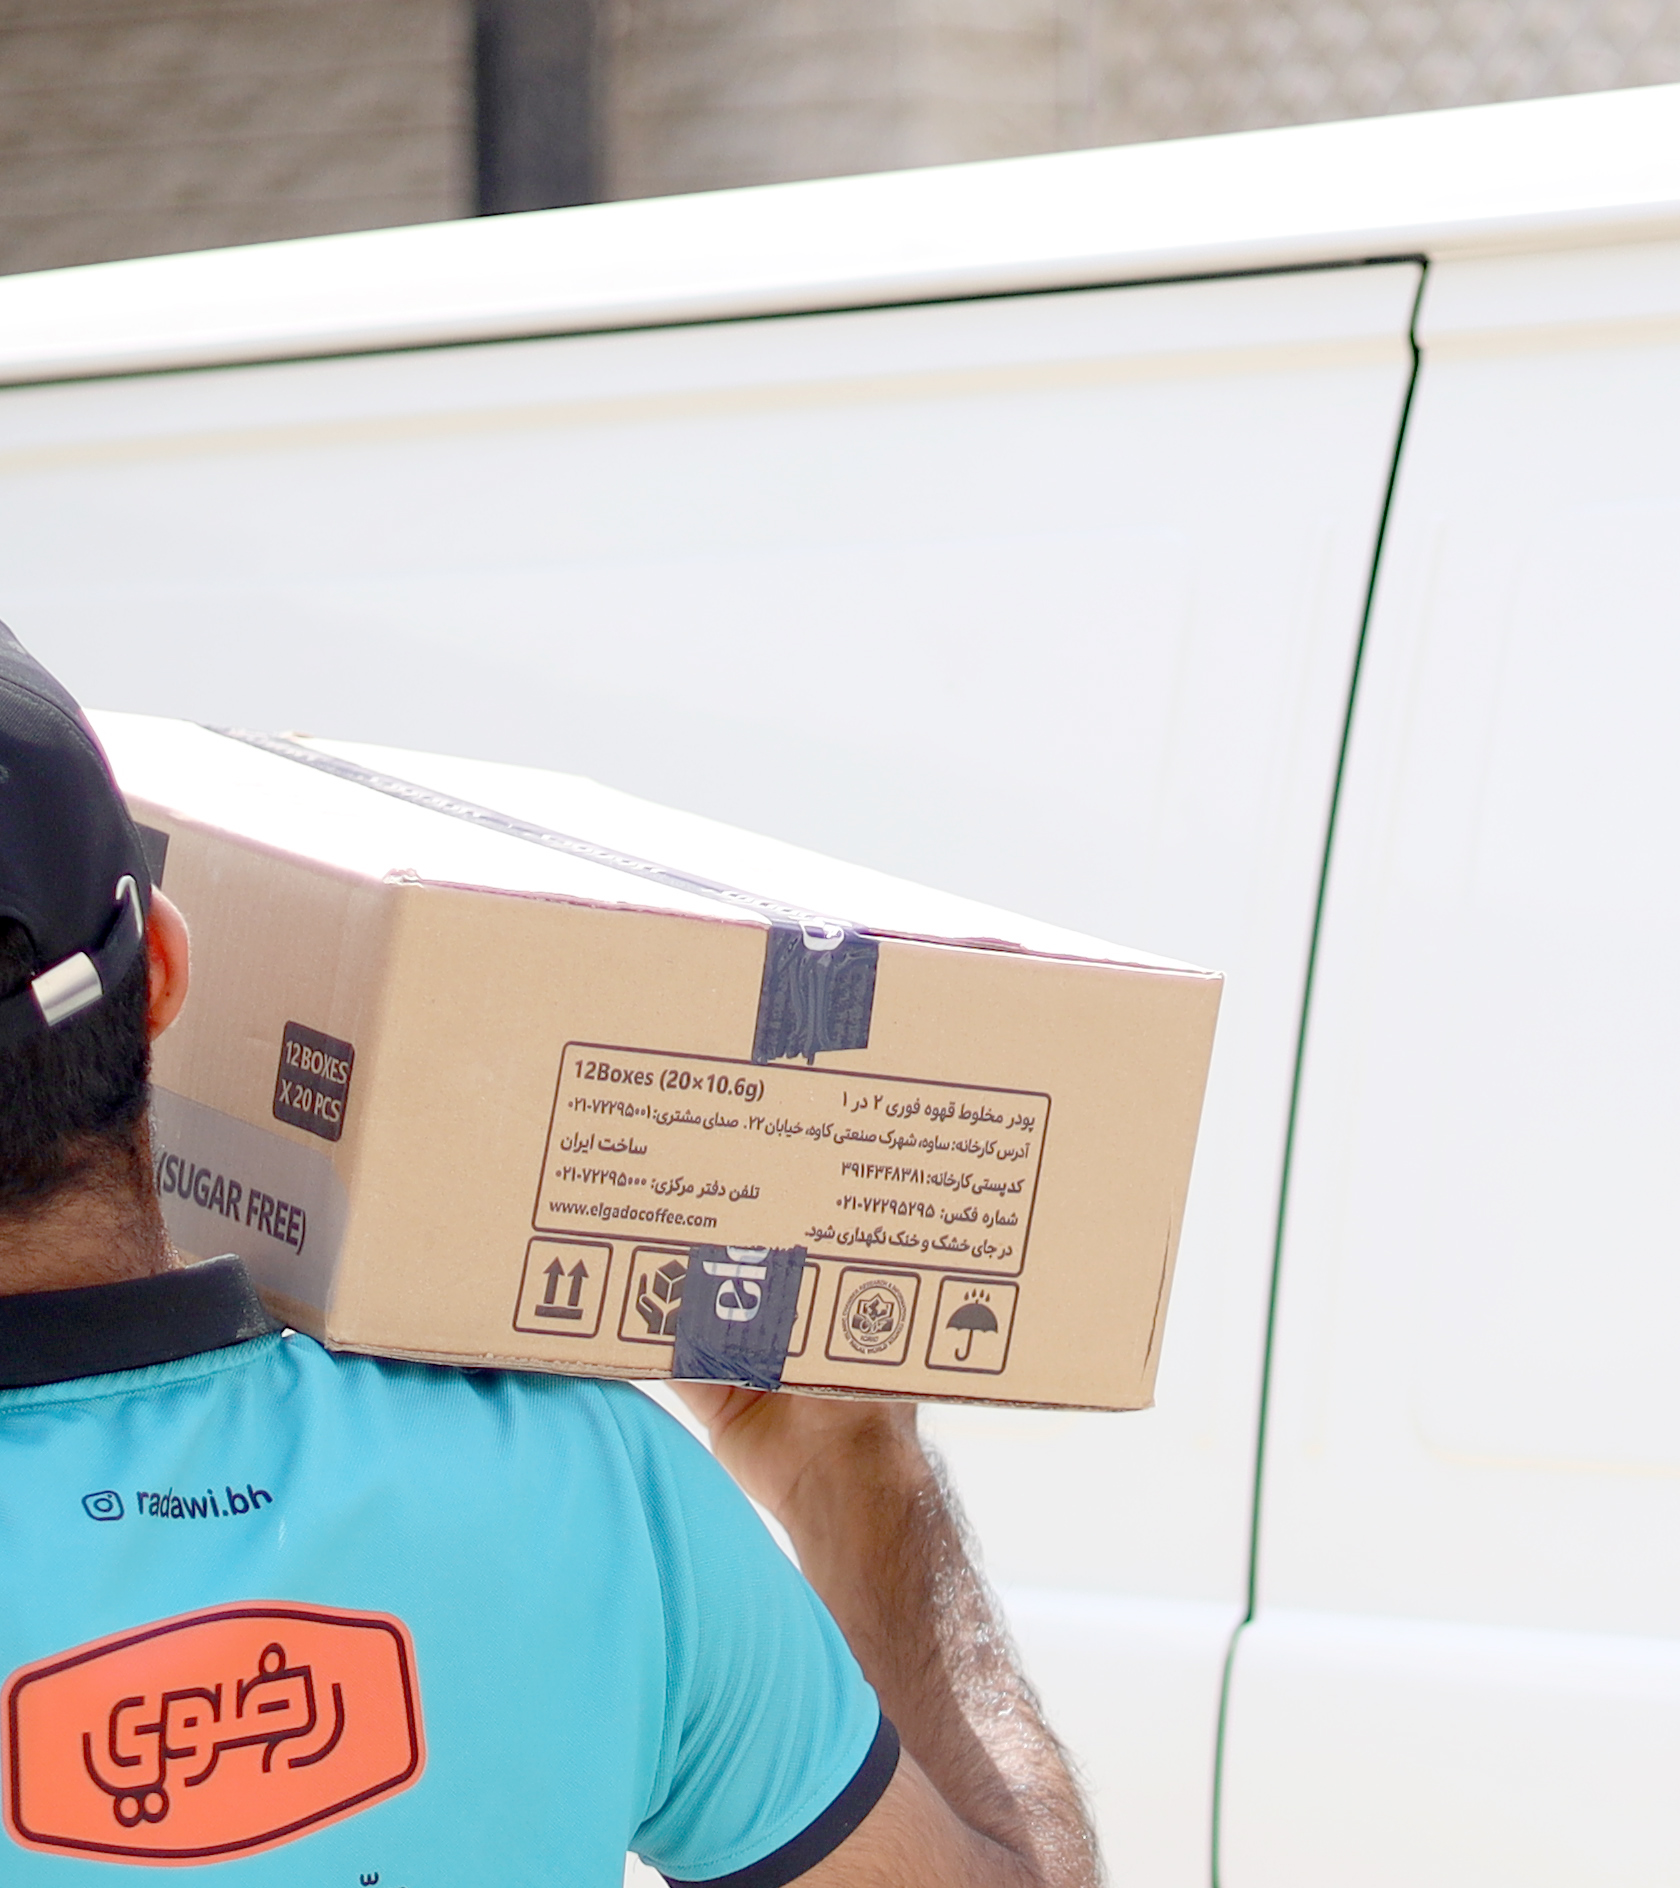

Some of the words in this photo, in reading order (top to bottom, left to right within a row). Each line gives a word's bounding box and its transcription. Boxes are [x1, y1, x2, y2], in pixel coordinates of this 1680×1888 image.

[574, 1060, 654, 1086] 12Boxes
[314, 1092, 341, 1123] PCS
[850, 1096, 868, 1113] در
[885, 1097, 921, 1118] فوری
[924, 1101, 956, 1122] قهوه
[958, 1102, 1004, 1126] مخلوط
[702, 1111, 739, 1131] صدای
[1005, 1113, 1036, 1133] پودر
[559, 1131, 595, 1154] ایران
[597, 1136, 648, 1156] ساخت
[833, 1128, 877, 1144] صنعتی
[878, 1129, 917, 1150] شهرک
[996, 1142, 1031, 1162] آدرس
[695, 1180, 726, 1198] دفتر
[728, 1184, 761, 1202] تلفن
[157, 1152, 243, 1222] (SUGAR
[246, 1188, 307, 1256] FREE)
[548, 1200, 718, 1228] www.elgadocoffee.com
[981, 1210, 1019, 1228] شماره
[920, 1240, 929, 1253] و
[930, 1234, 970, 1252] خشک
[971, 1239, 997, 1258] جای
[997, 1242, 1014, 1260] در
[135, 1483, 274, 1520] radawi.bh
